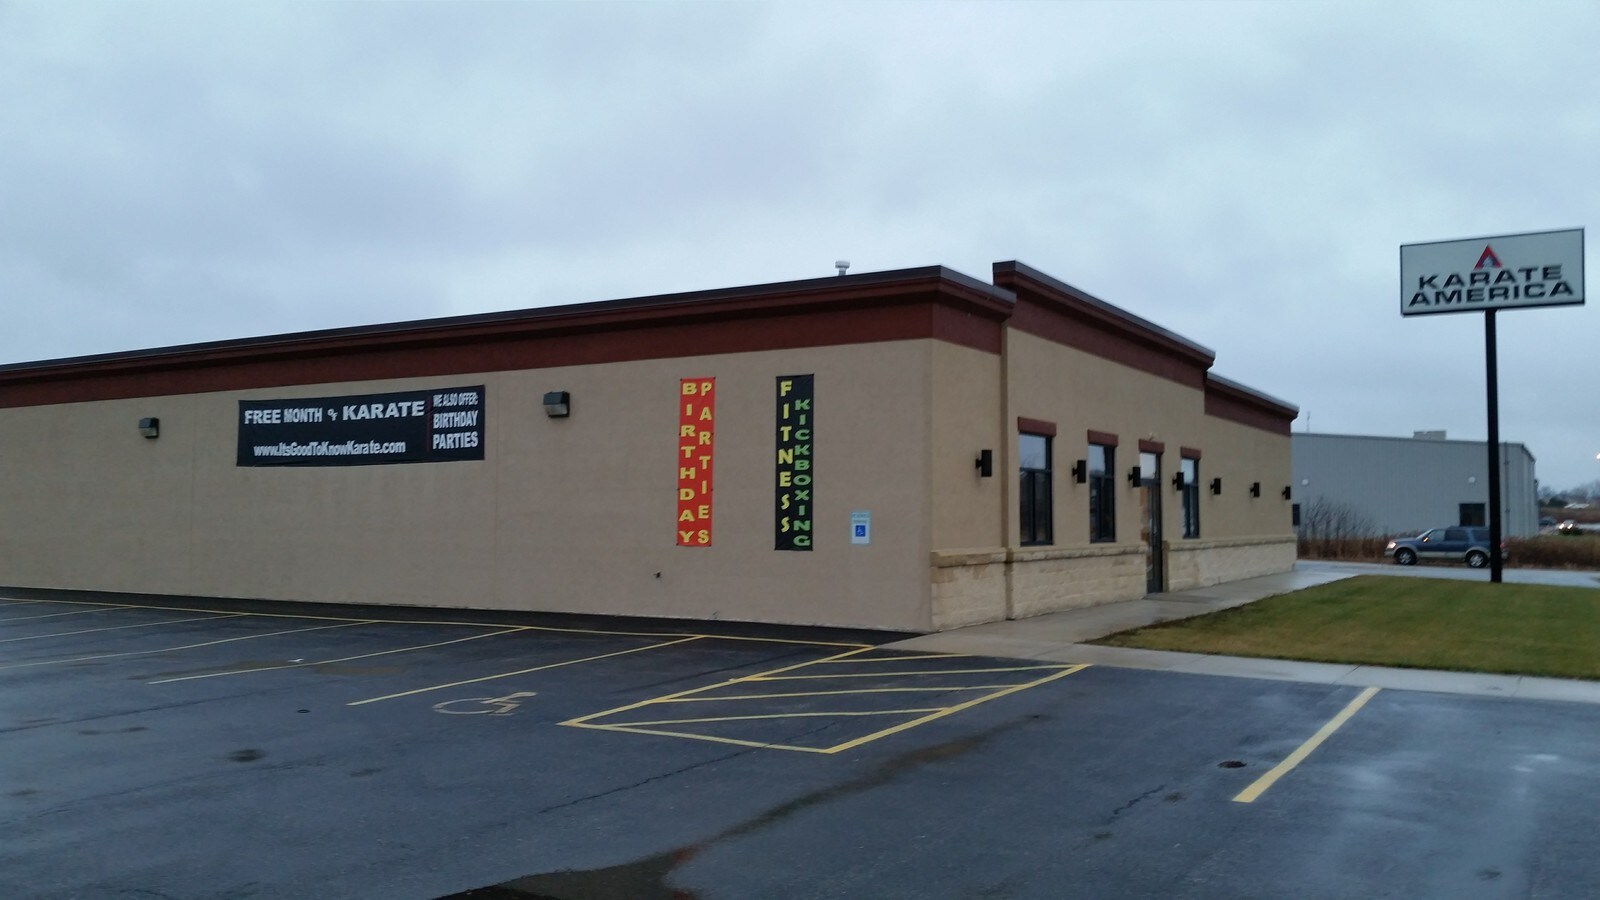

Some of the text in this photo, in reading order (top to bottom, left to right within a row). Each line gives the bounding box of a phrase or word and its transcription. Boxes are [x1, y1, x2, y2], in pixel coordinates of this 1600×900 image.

[1418, 264, 1563, 290] KARATE
[1408, 281, 1574, 307] AMERICA
[244, 409, 281, 424] FREE
[283, 407, 323, 423] MONTH
[342, 400, 425, 420] KARATE
[433, 394, 443, 407] WE
[443, 392, 458, 406] ALSO
[433, 409, 479, 429] BIRTHDAY
[253, 440, 406, 456] www.ItsGoodToKnowKarate.com
[432, 431, 479, 450] PARTIES
[678, 382, 697, 543] BIRTHDAY
[697, 382, 712, 544] PARTIES
[778, 380, 793, 533] FITNESS
[793, 399, 811, 546] KICKBOXING
